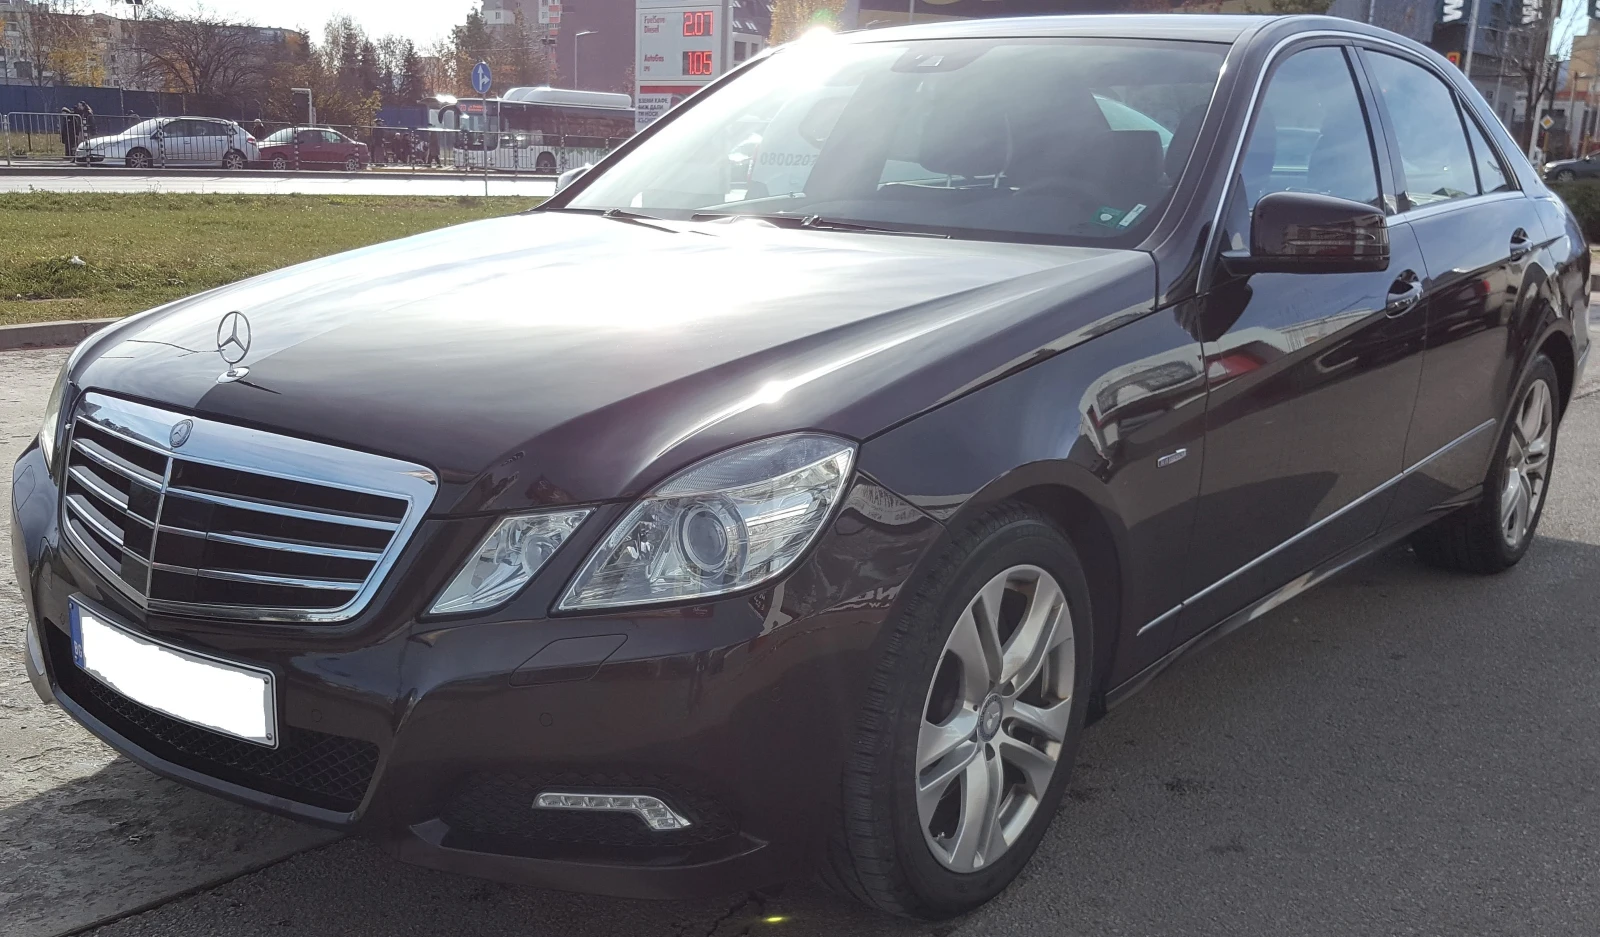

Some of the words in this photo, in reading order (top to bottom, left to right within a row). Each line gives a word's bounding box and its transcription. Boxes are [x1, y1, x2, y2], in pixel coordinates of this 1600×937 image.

[644, 15, 665, 24] FuelSave
[683, 11, 714, 36] 2.07
[644, 25, 660, 34] Diesel
[644, 54, 664, 62] AutoGas
[687, 51, 713, 75] 1.05
